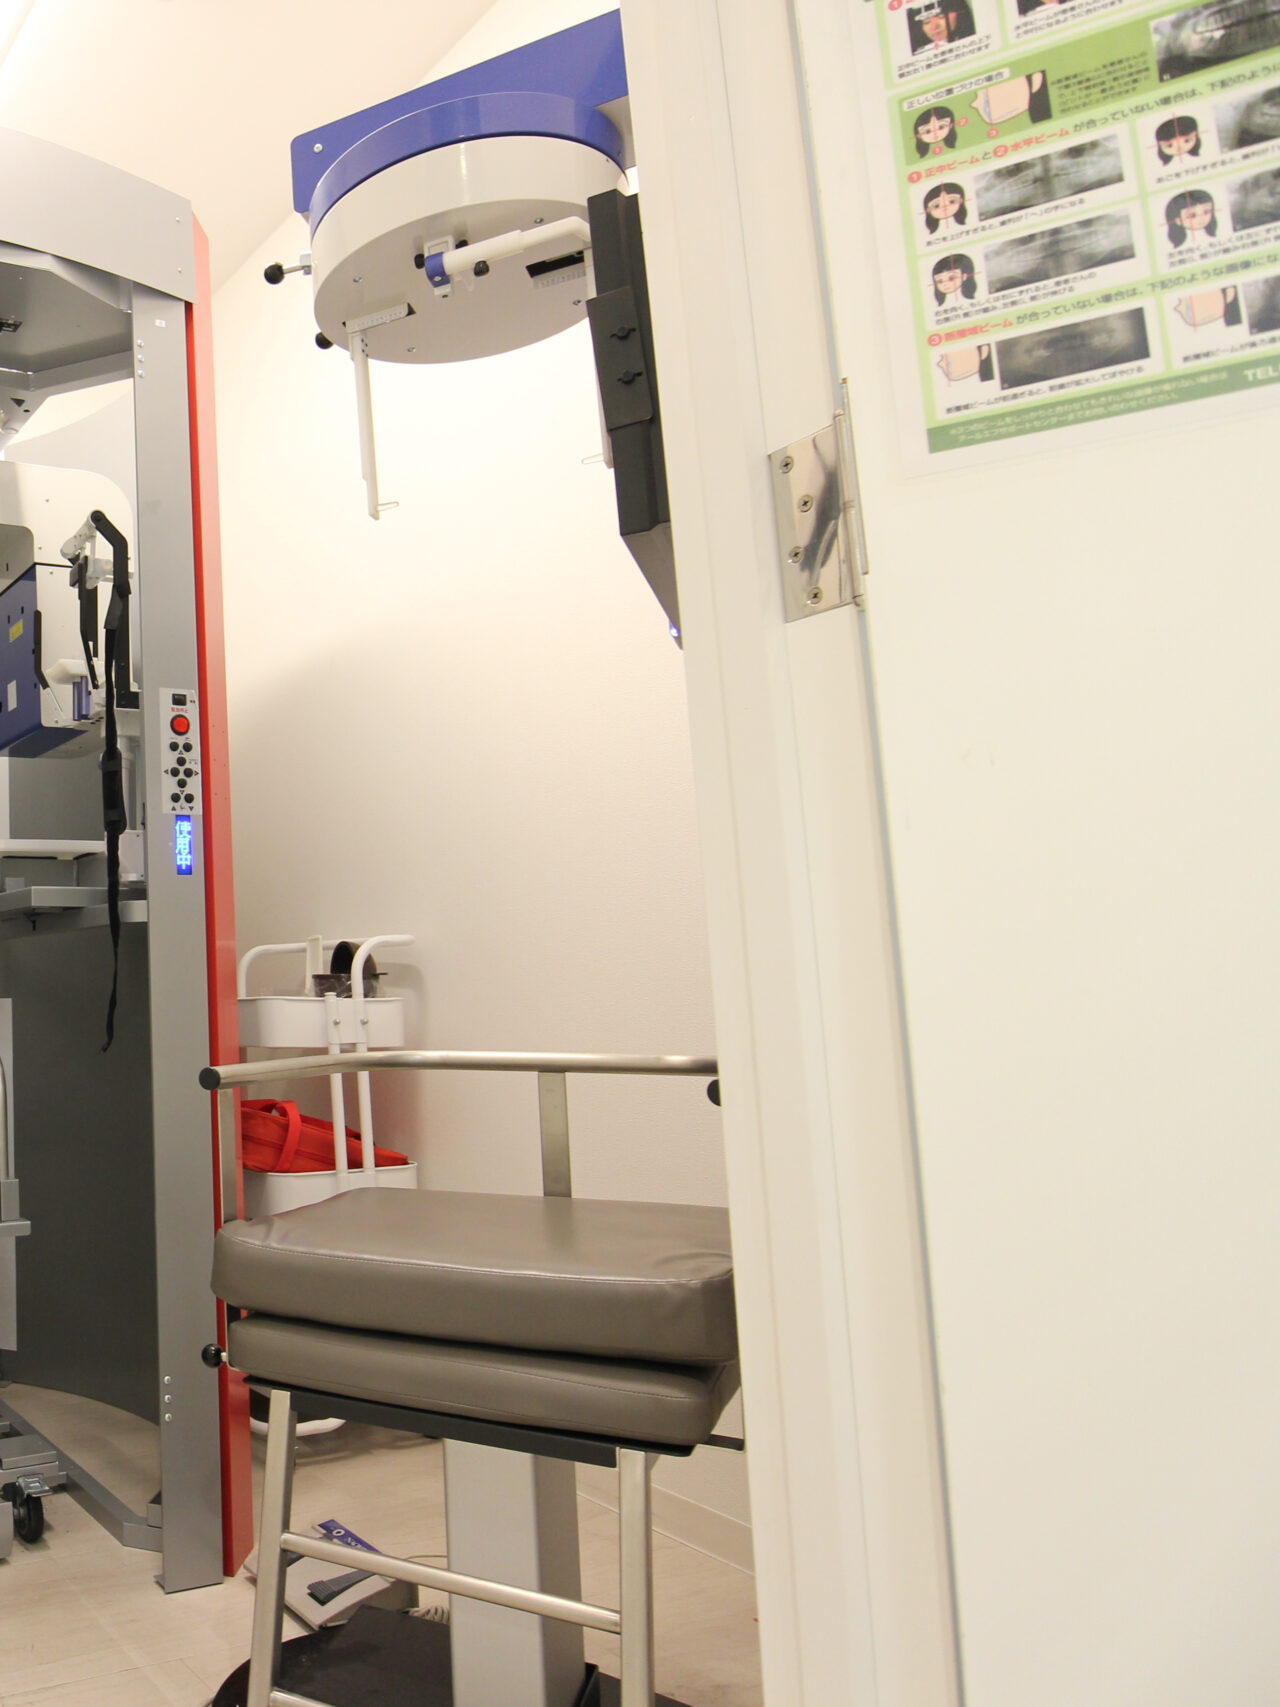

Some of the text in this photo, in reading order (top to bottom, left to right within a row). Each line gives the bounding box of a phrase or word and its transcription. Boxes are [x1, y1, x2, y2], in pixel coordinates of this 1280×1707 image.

[1244, 365, 1279, 382] TEL
[175, 820, 192, 870] 使用中
